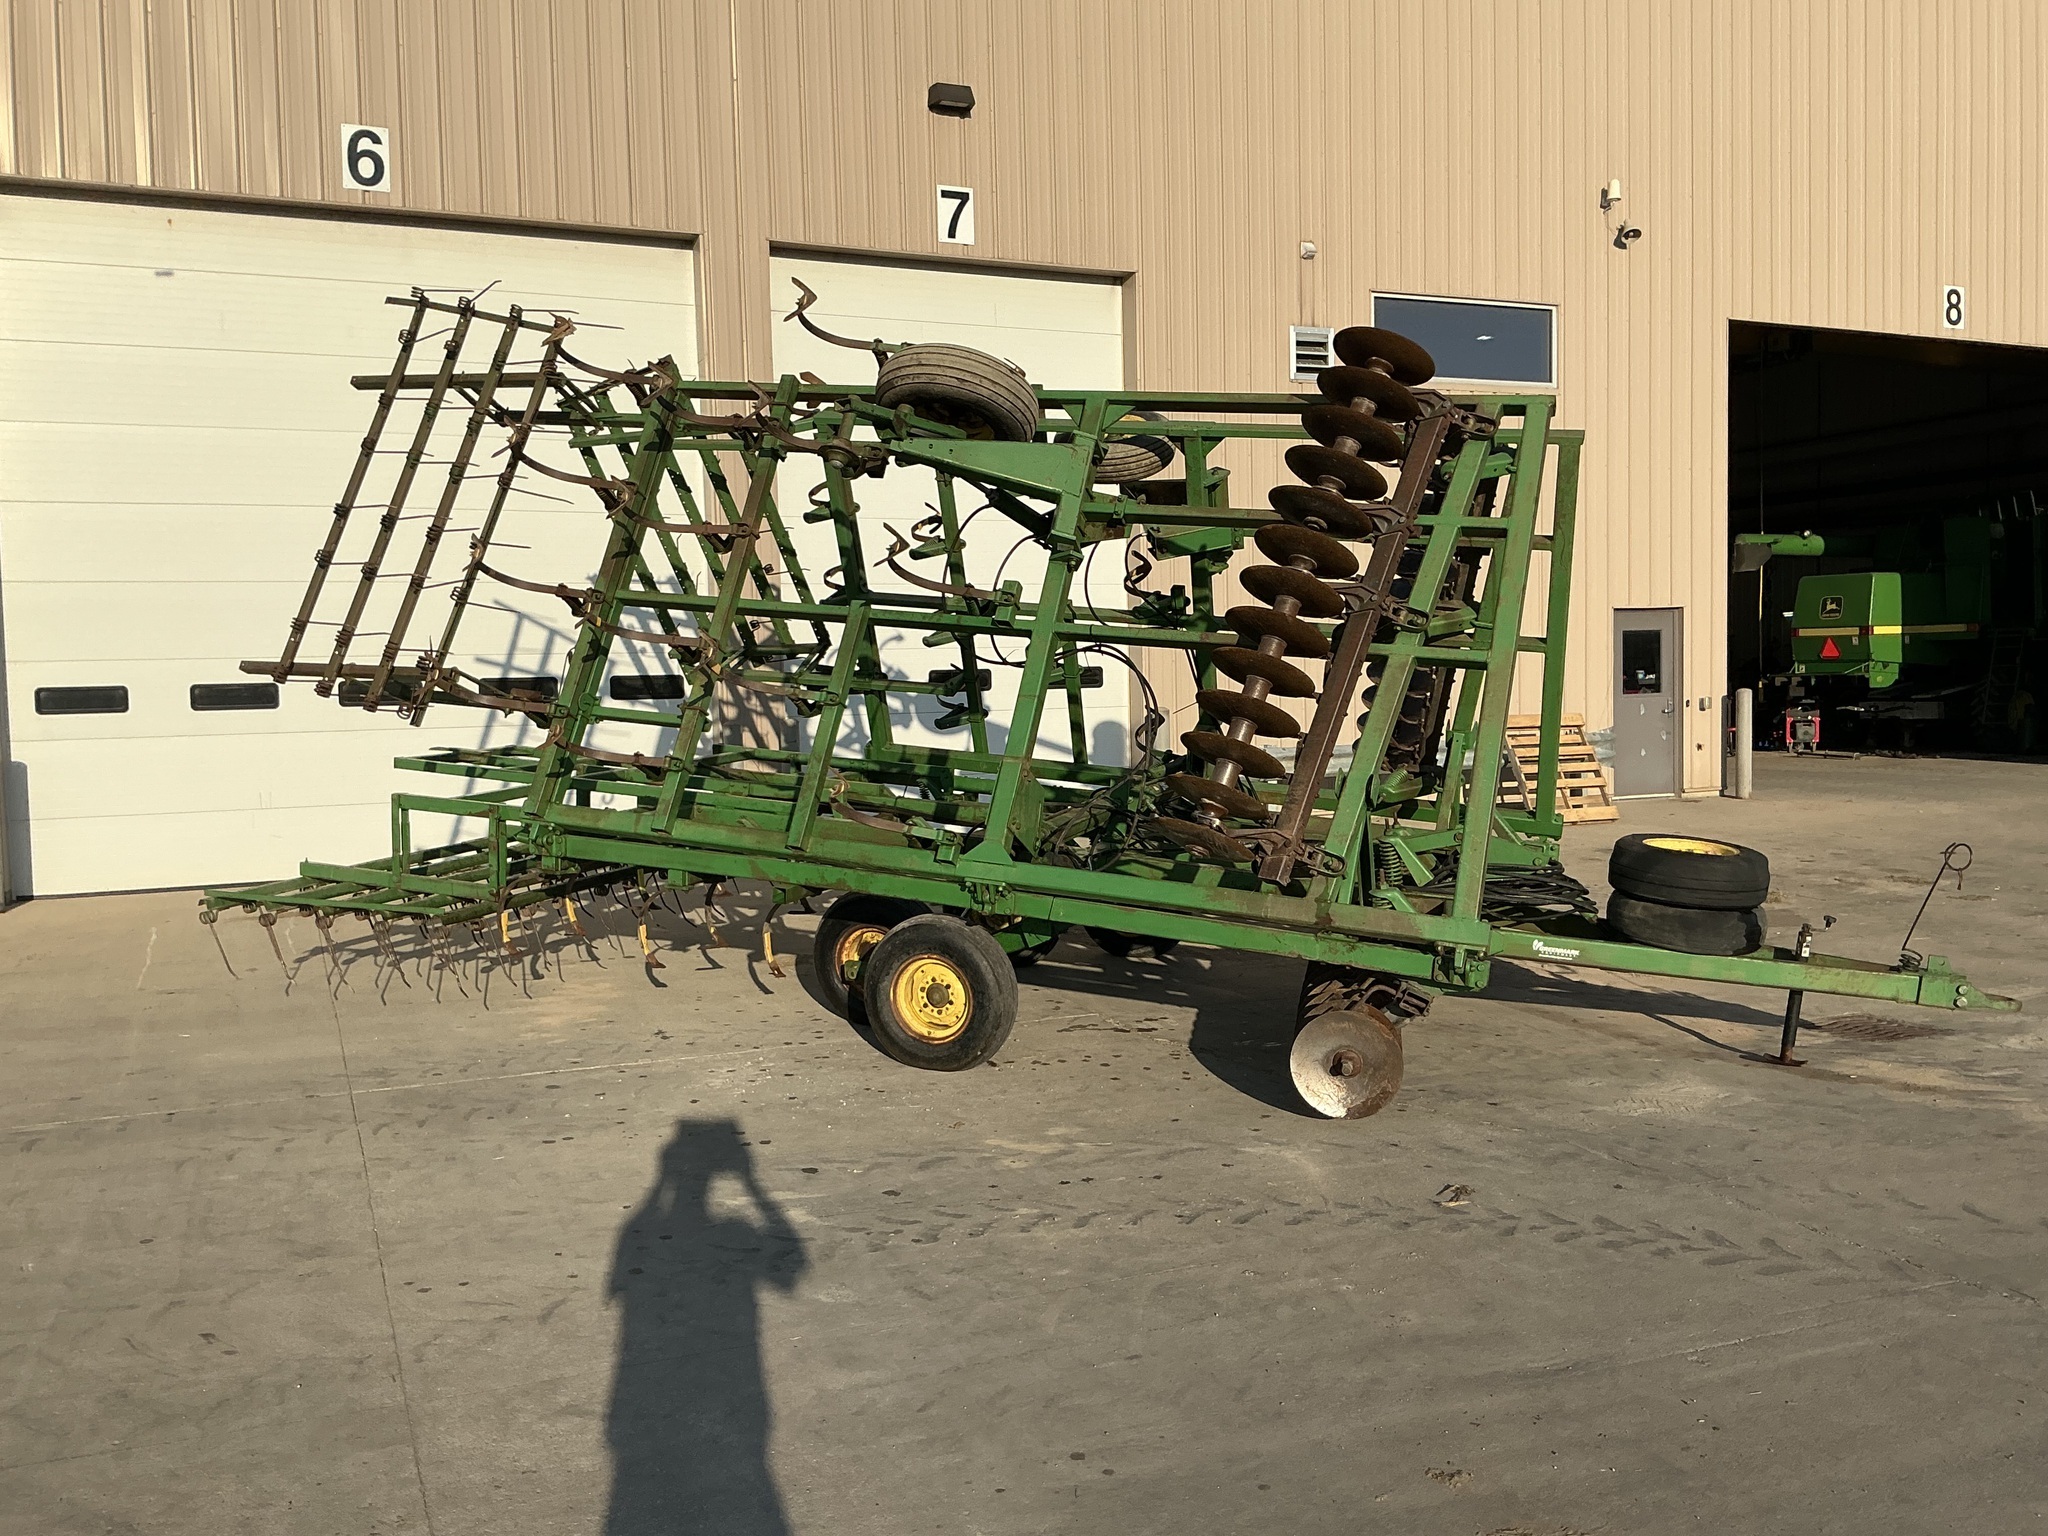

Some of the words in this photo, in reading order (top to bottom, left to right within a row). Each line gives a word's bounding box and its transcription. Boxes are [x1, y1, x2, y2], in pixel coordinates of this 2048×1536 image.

[347, 129, 385, 187] 6
[940, 190, 970, 239] 7
[1945, 288, 1962, 326] 8
